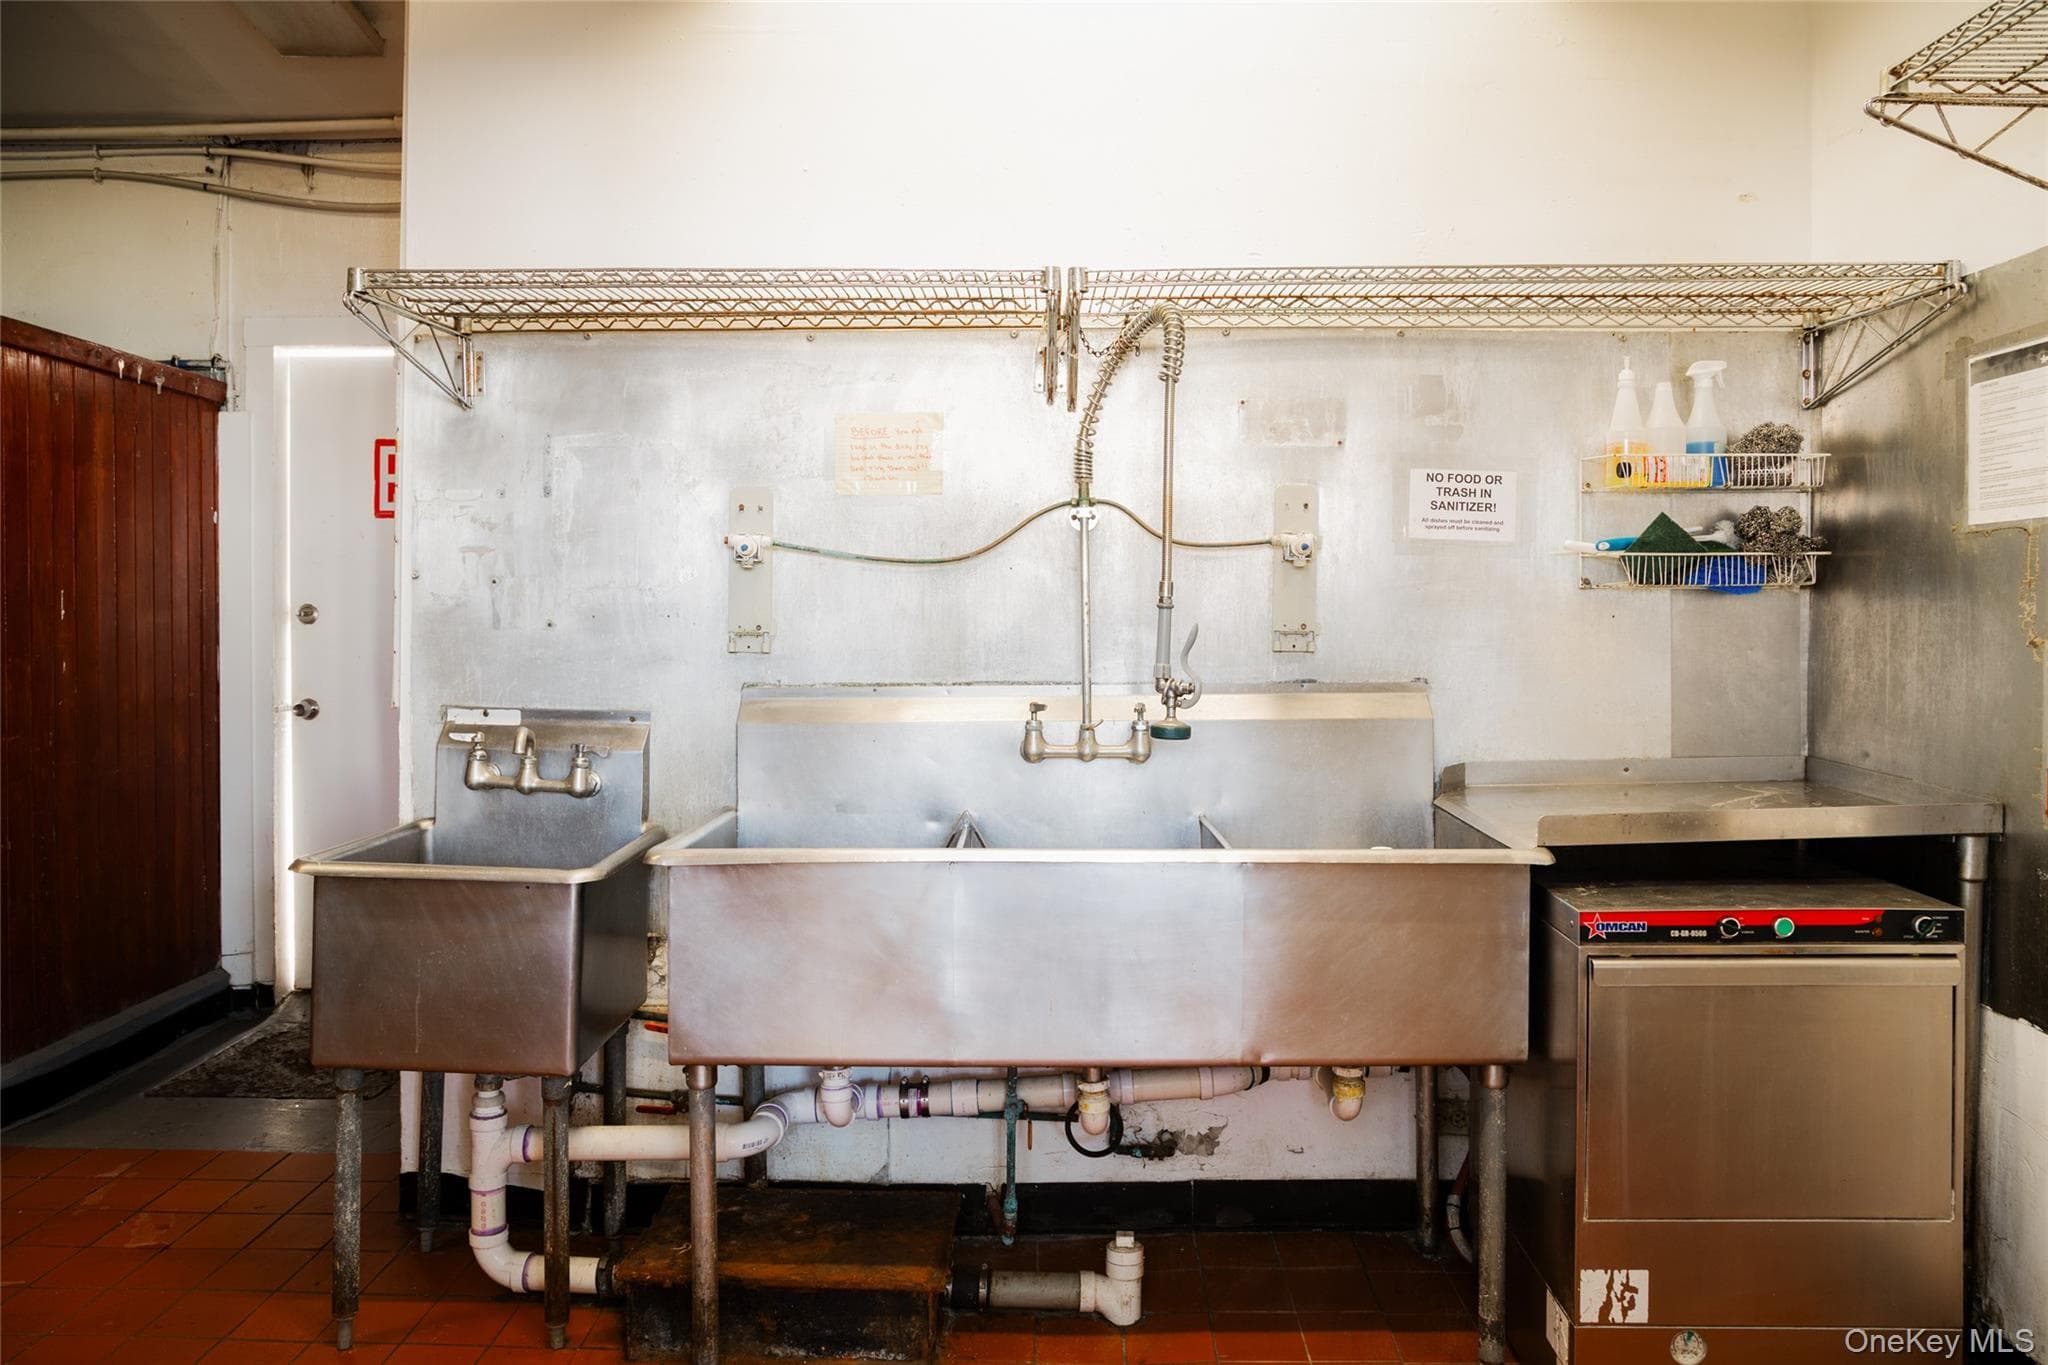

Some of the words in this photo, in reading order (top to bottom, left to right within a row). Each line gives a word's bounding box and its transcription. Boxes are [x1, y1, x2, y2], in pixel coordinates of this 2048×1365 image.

[849, 426, 888, 437] BEFORE
[1426, 473, 1444, 482] NO
[1447, 473, 1481, 484] FOOD
[1485, 475, 1503, 485] OR
[1436, 487, 1477, 498] TRASH
[1480, 489, 1492, 498] IN
[1430, 500, 1497, 512] SANITIZER!
[1595, 921, 1647, 933] OMCAN
